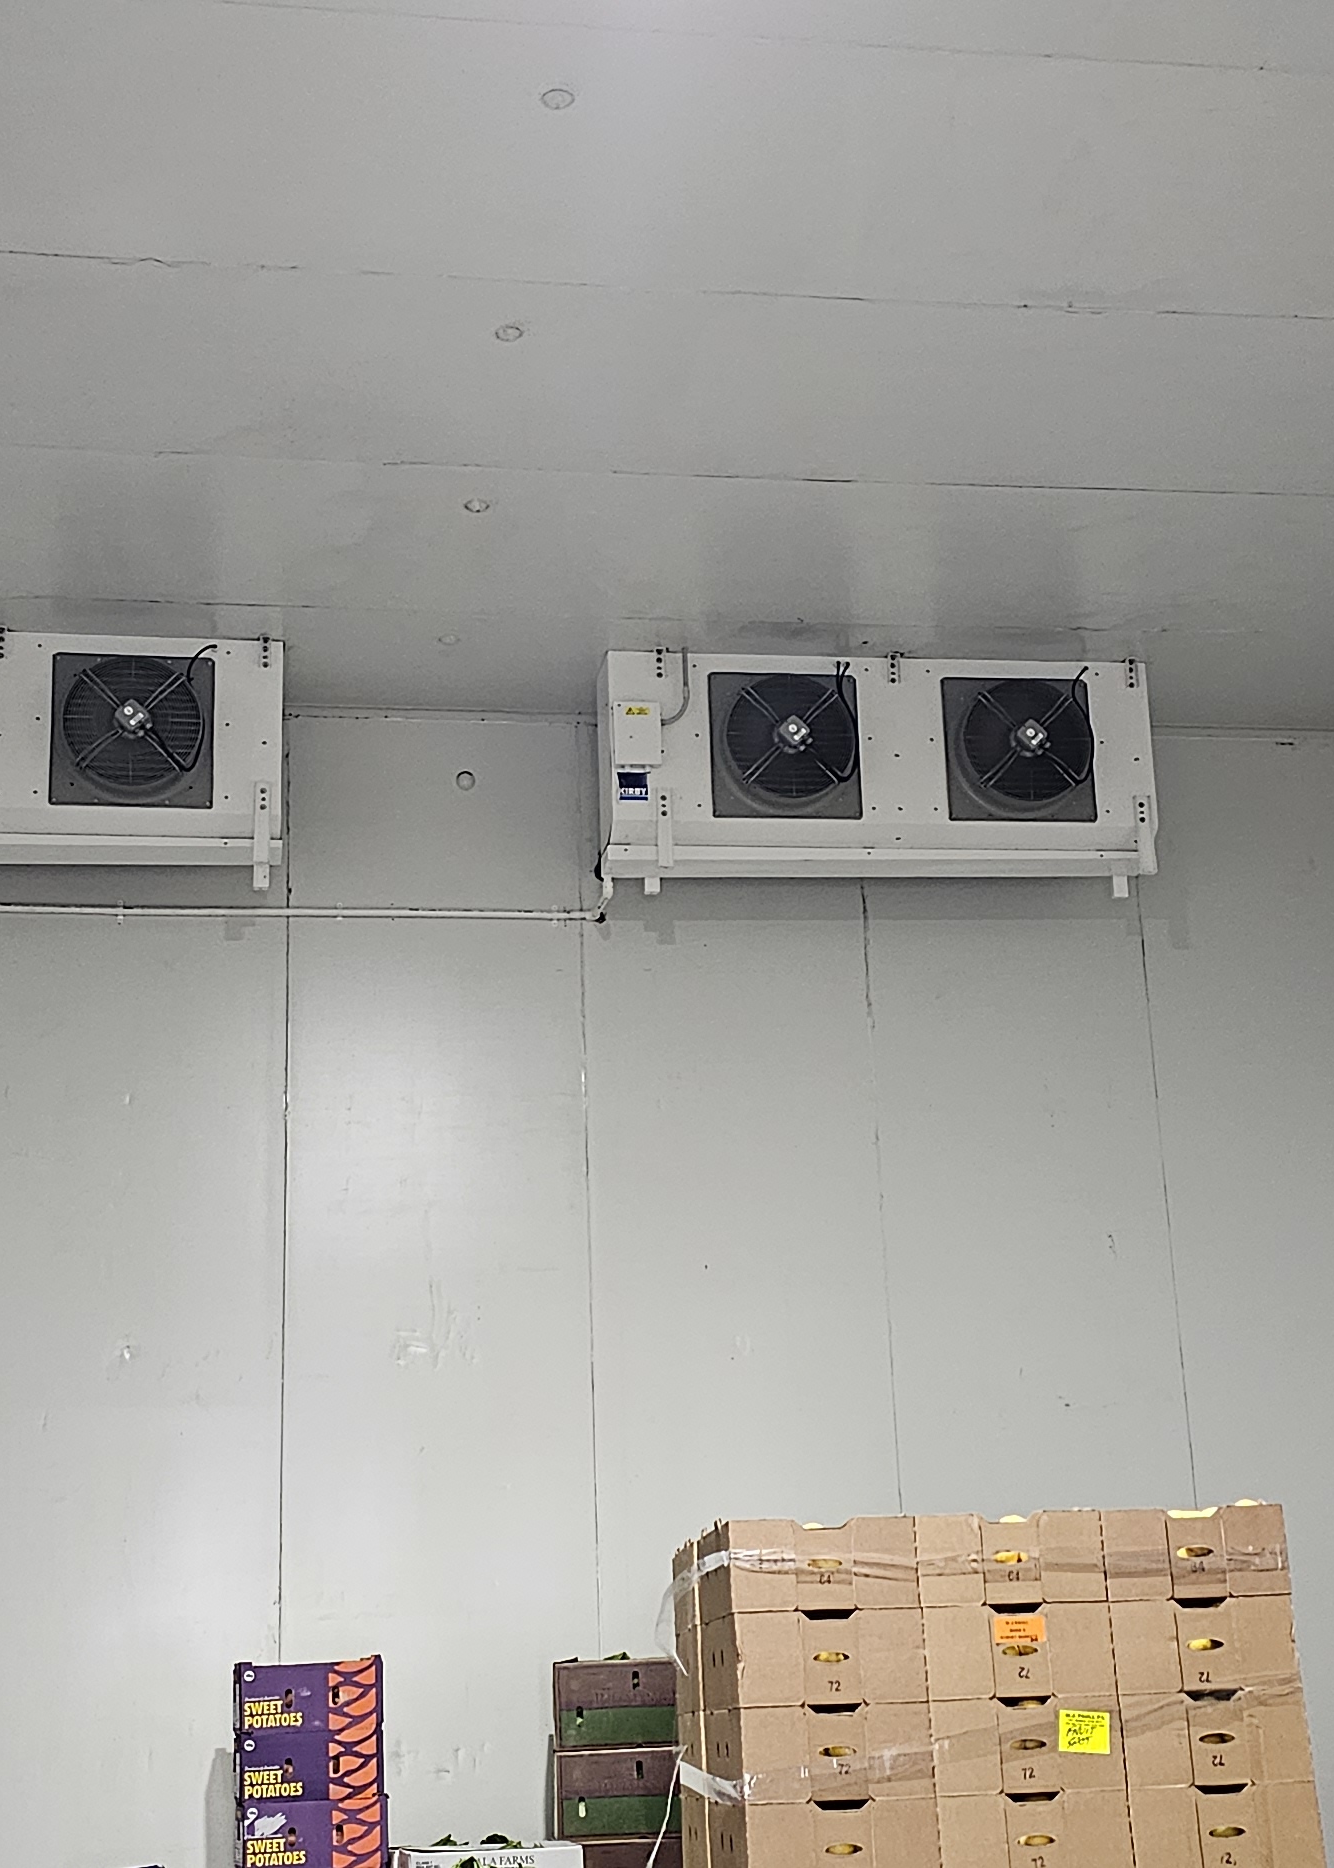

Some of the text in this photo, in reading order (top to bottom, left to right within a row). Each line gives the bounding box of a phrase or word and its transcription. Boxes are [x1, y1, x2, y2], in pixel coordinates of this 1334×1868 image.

[620, 788, 647, 796] KIRBY
[828, 1680, 841, 1692] 72
[244, 1700, 283, 1715] SWEET
[244, 1712, 303, 1729] POTATOES
[837, 1763, 851, 1775] 72
[1022, 1766, 1036, 1780] 72
[244, 1770, 283, 1785] SWEET
[244, 1782, 303, 1799] POTATOES
[247, 1838, 286, 1853] SWEET
[247, 1851, 306, 1867] POTATOES
[499, 1855, 535, 1865] FARMS
[1031, 1856, 1046, 1868] 72
